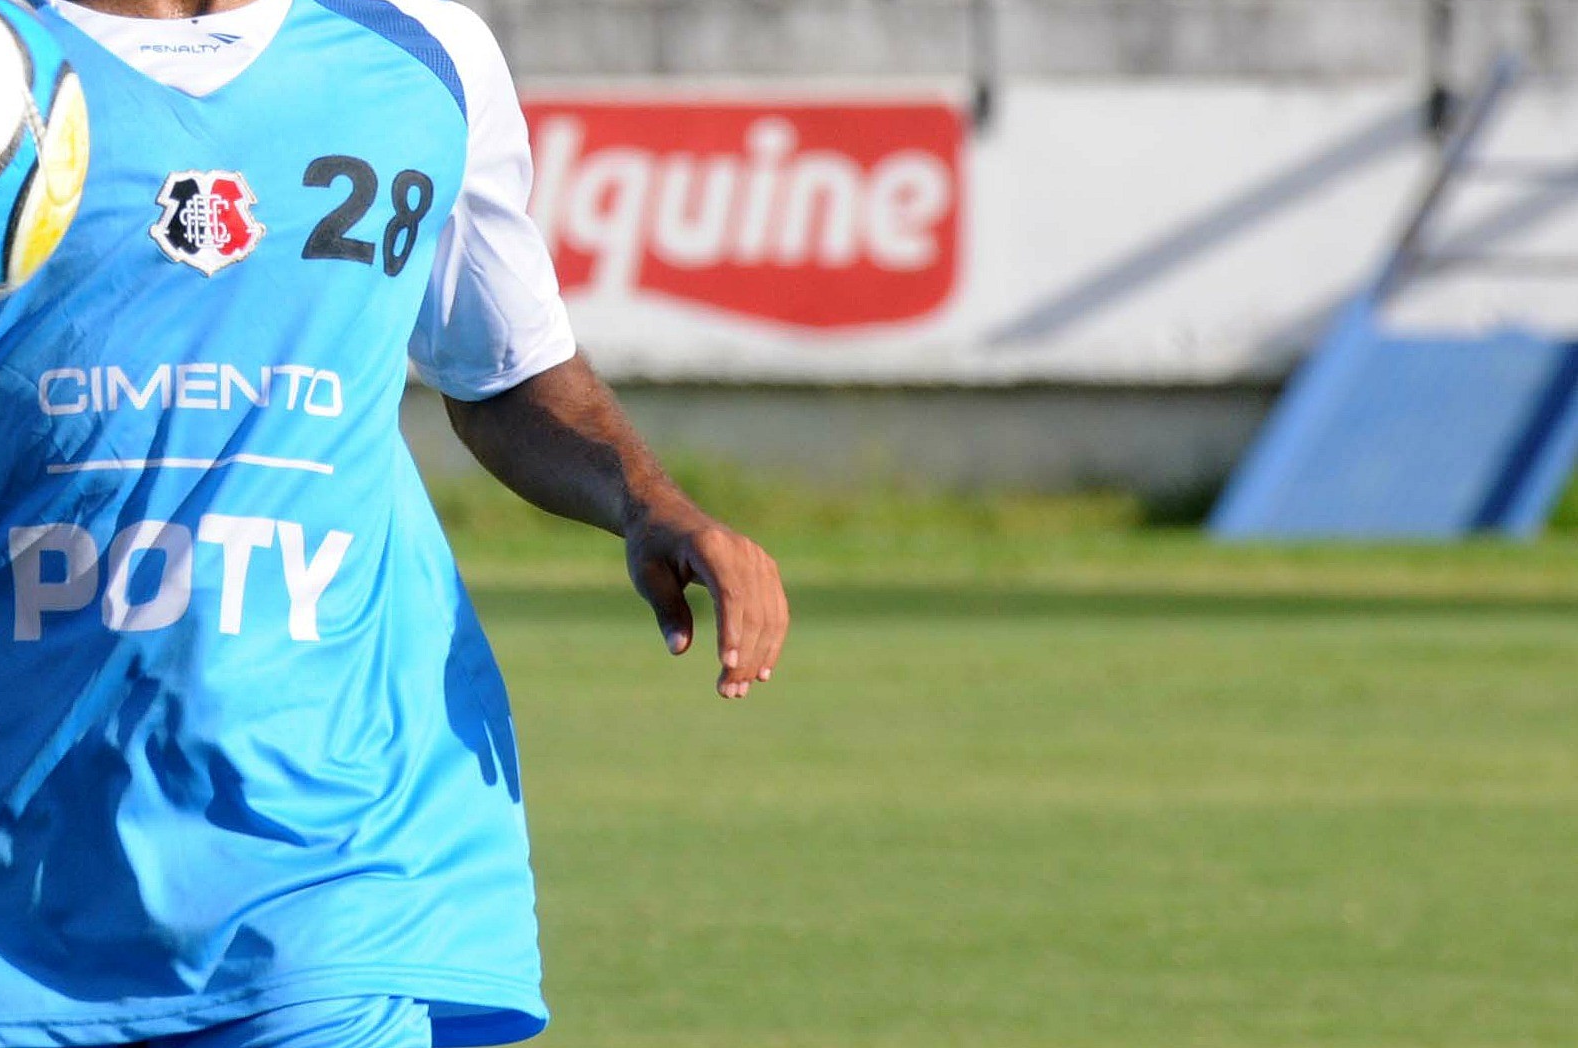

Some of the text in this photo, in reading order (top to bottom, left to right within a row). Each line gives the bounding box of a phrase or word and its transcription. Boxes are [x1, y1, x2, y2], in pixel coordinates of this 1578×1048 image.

[139, 44, 221, 54] PENALTY
[301, 154, 434, 277] 28
[531, 114, 950, 295] Iquine
[39, 363, 344, 417] CIMENTO
[9, 515, 353, 642] POTY
